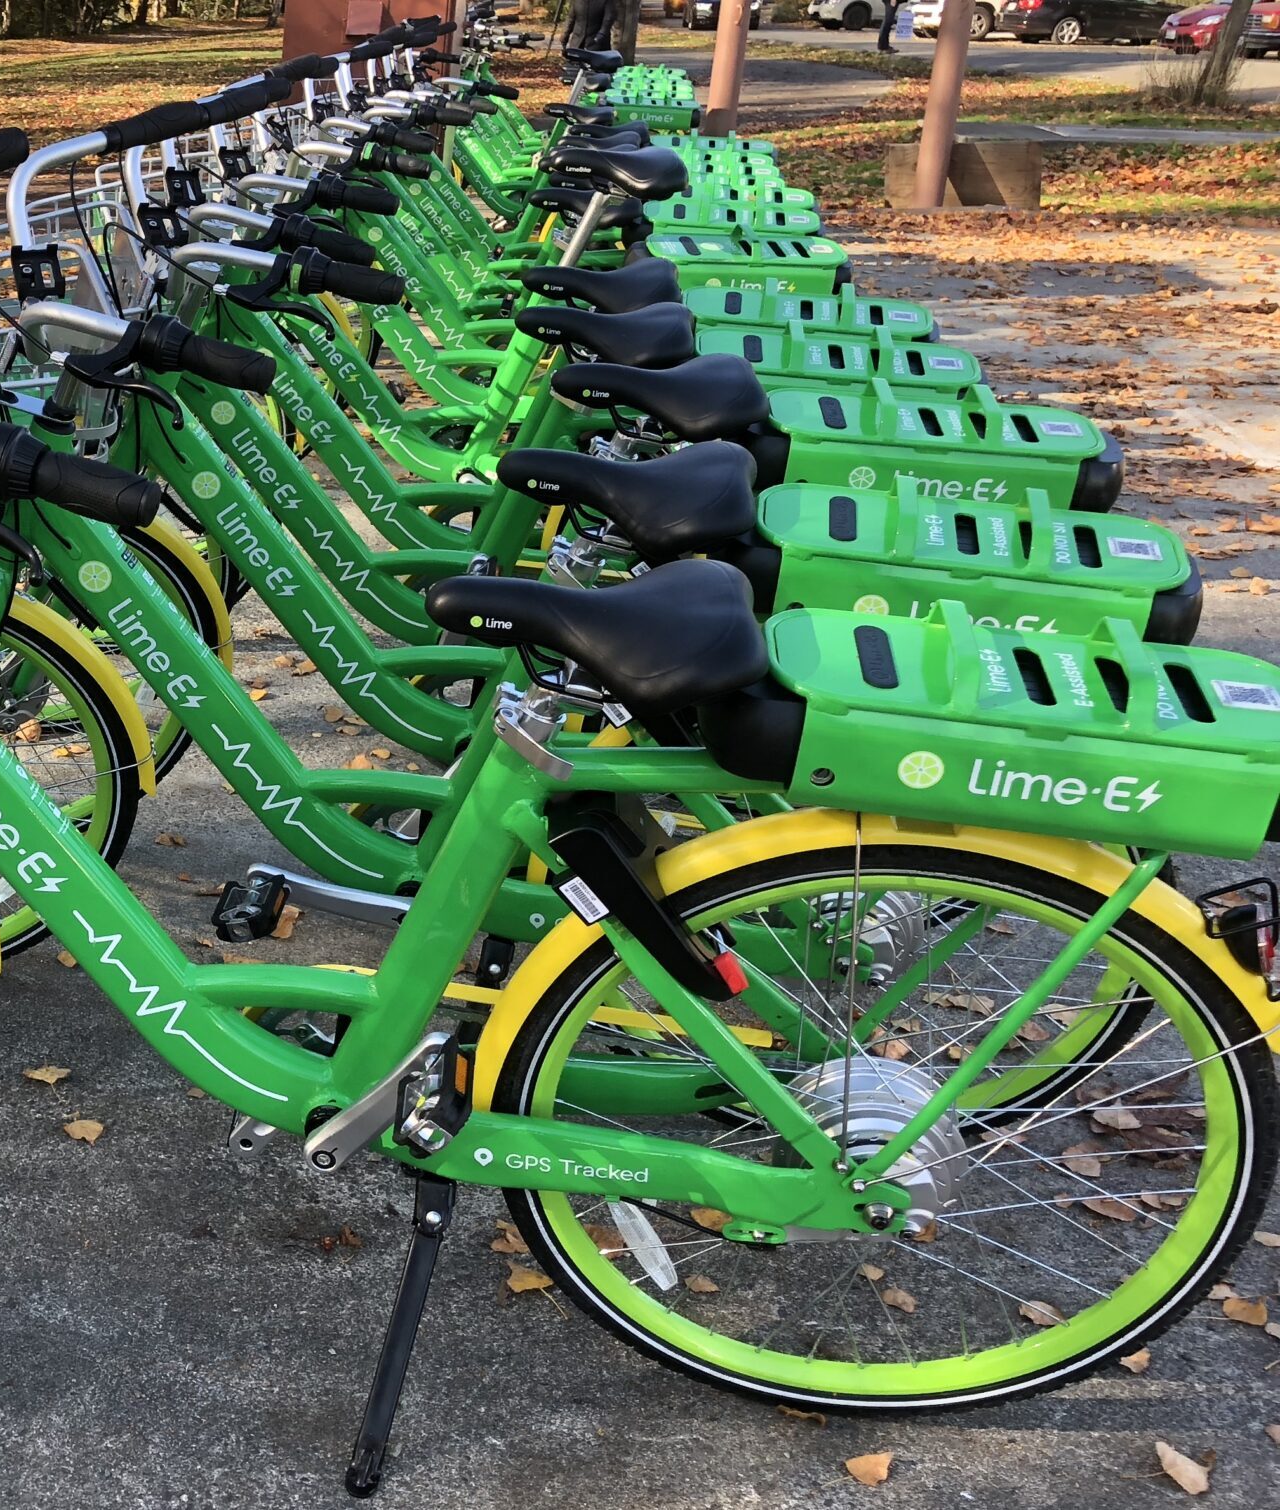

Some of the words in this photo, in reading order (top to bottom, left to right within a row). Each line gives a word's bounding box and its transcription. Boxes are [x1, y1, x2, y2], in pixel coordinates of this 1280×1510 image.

[592, 390, 610, 398] Lime
[539, 481, 560, 491] Lime
[485, 618, 513, 630] Lime
[505, 1153, 551, 1173] GPS
[558, 1158, 649, 1183] Tracked
